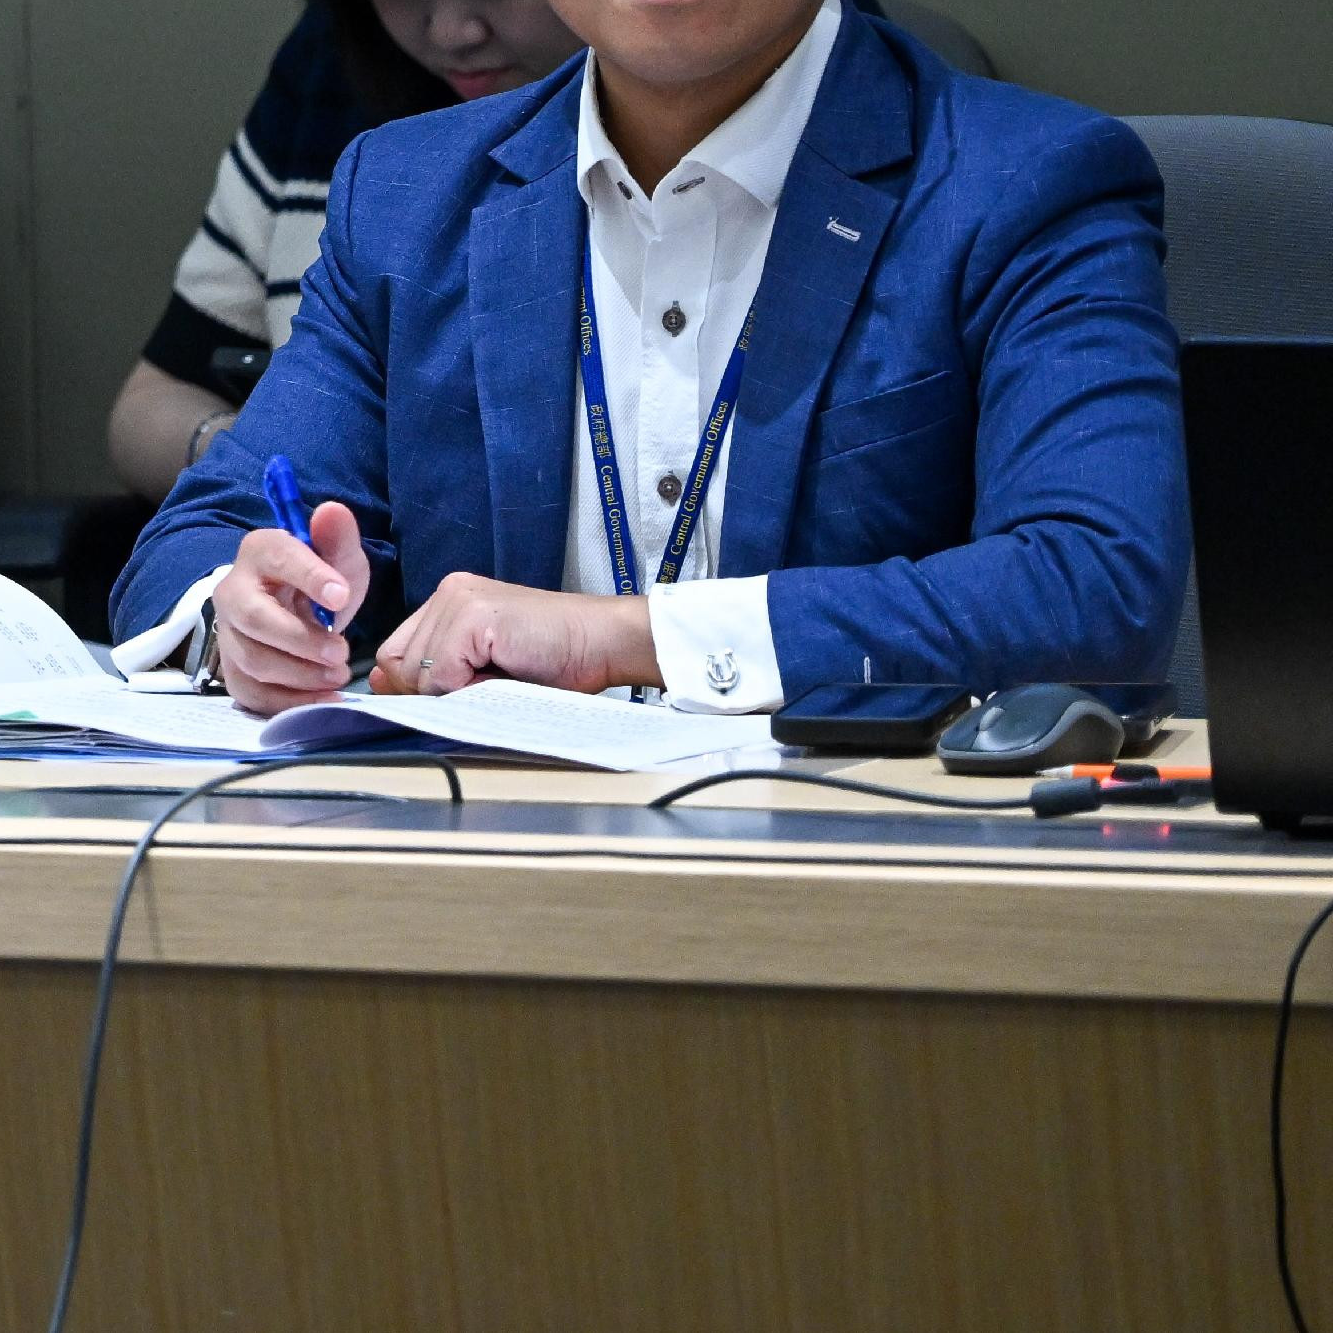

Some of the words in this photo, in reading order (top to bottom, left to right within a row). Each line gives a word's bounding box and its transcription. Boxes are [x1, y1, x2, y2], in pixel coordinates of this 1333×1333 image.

[601, 465, 619, 506] Central
[670, 514, 692, 555] Central
[684, 443, 714, 513] Government
[706, 401, 729, 442] Offices
[609, 508, 629, 577] Government
